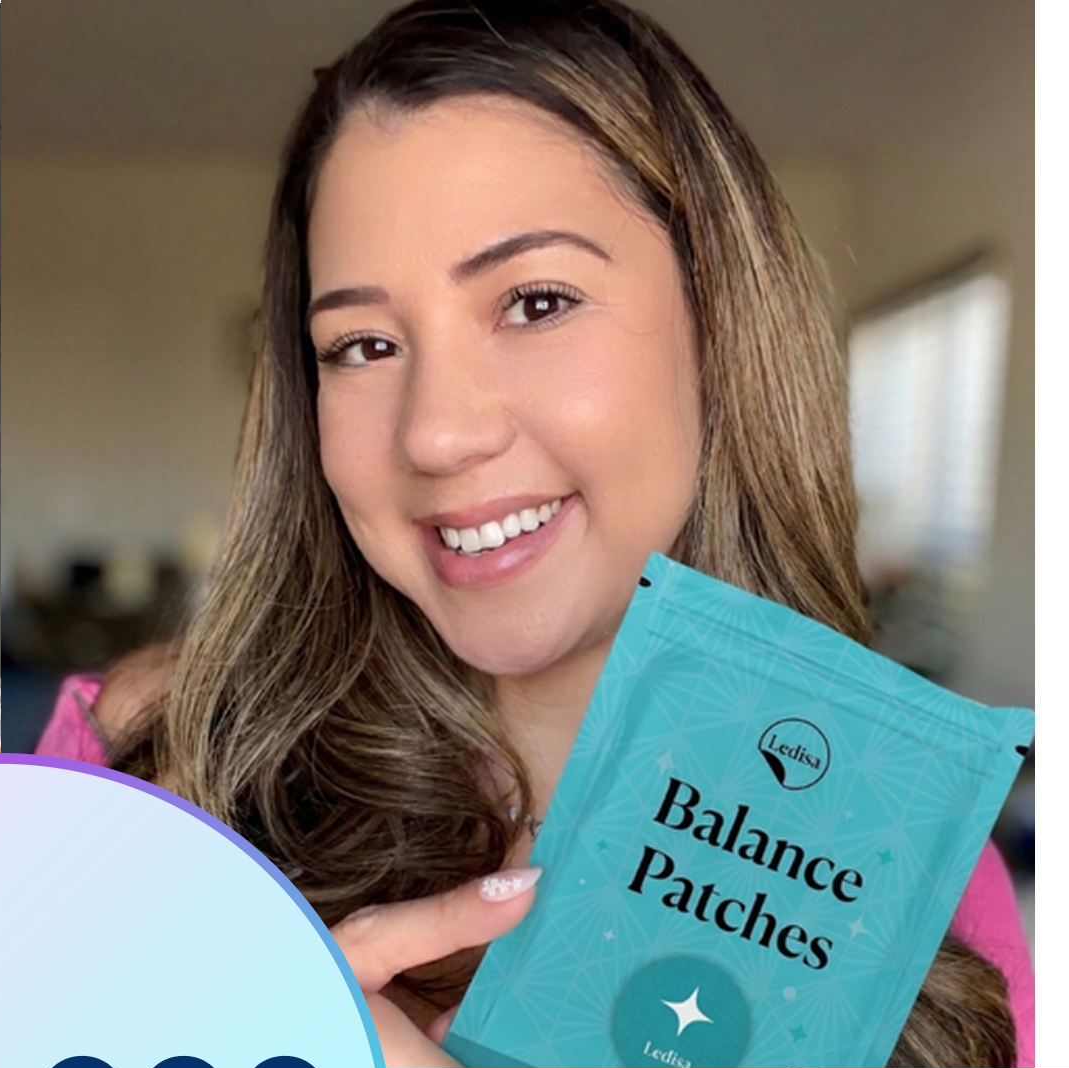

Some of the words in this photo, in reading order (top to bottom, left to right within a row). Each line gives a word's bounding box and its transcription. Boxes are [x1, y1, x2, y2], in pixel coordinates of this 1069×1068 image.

[768, 734, 822, 770] Ledisa
[653, 777, 863, 903] Balance
[627, 845, 834, 970] Patches
